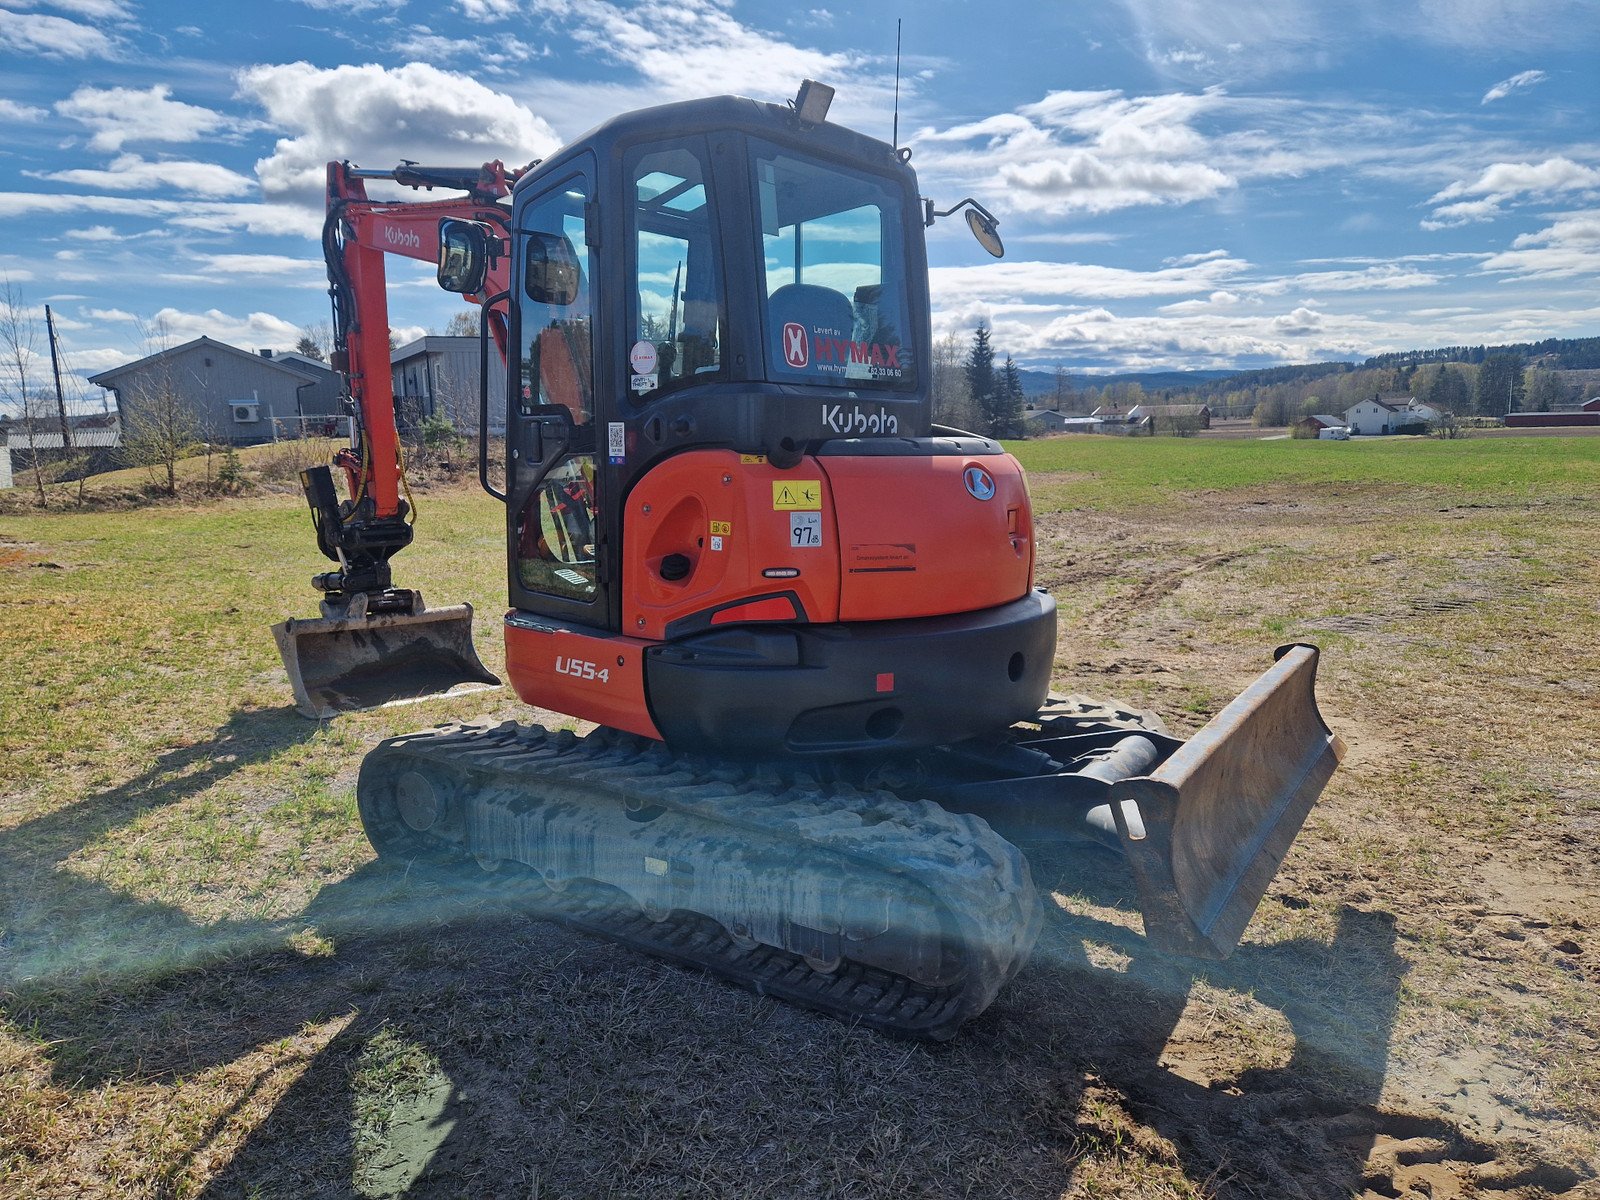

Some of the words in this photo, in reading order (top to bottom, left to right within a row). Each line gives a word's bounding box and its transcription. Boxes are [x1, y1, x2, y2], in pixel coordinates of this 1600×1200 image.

[384, 225, 420, 248] Kubota
[813, 325, 834, 335] Levert
[814, 336, 900, 368] HYMAX
[822, 404, 898, 434] Kubota
[793, 526, 812, 544] 97
[811, 534, 820, 544] dB
[555, 655, 609, 683] U55-4
